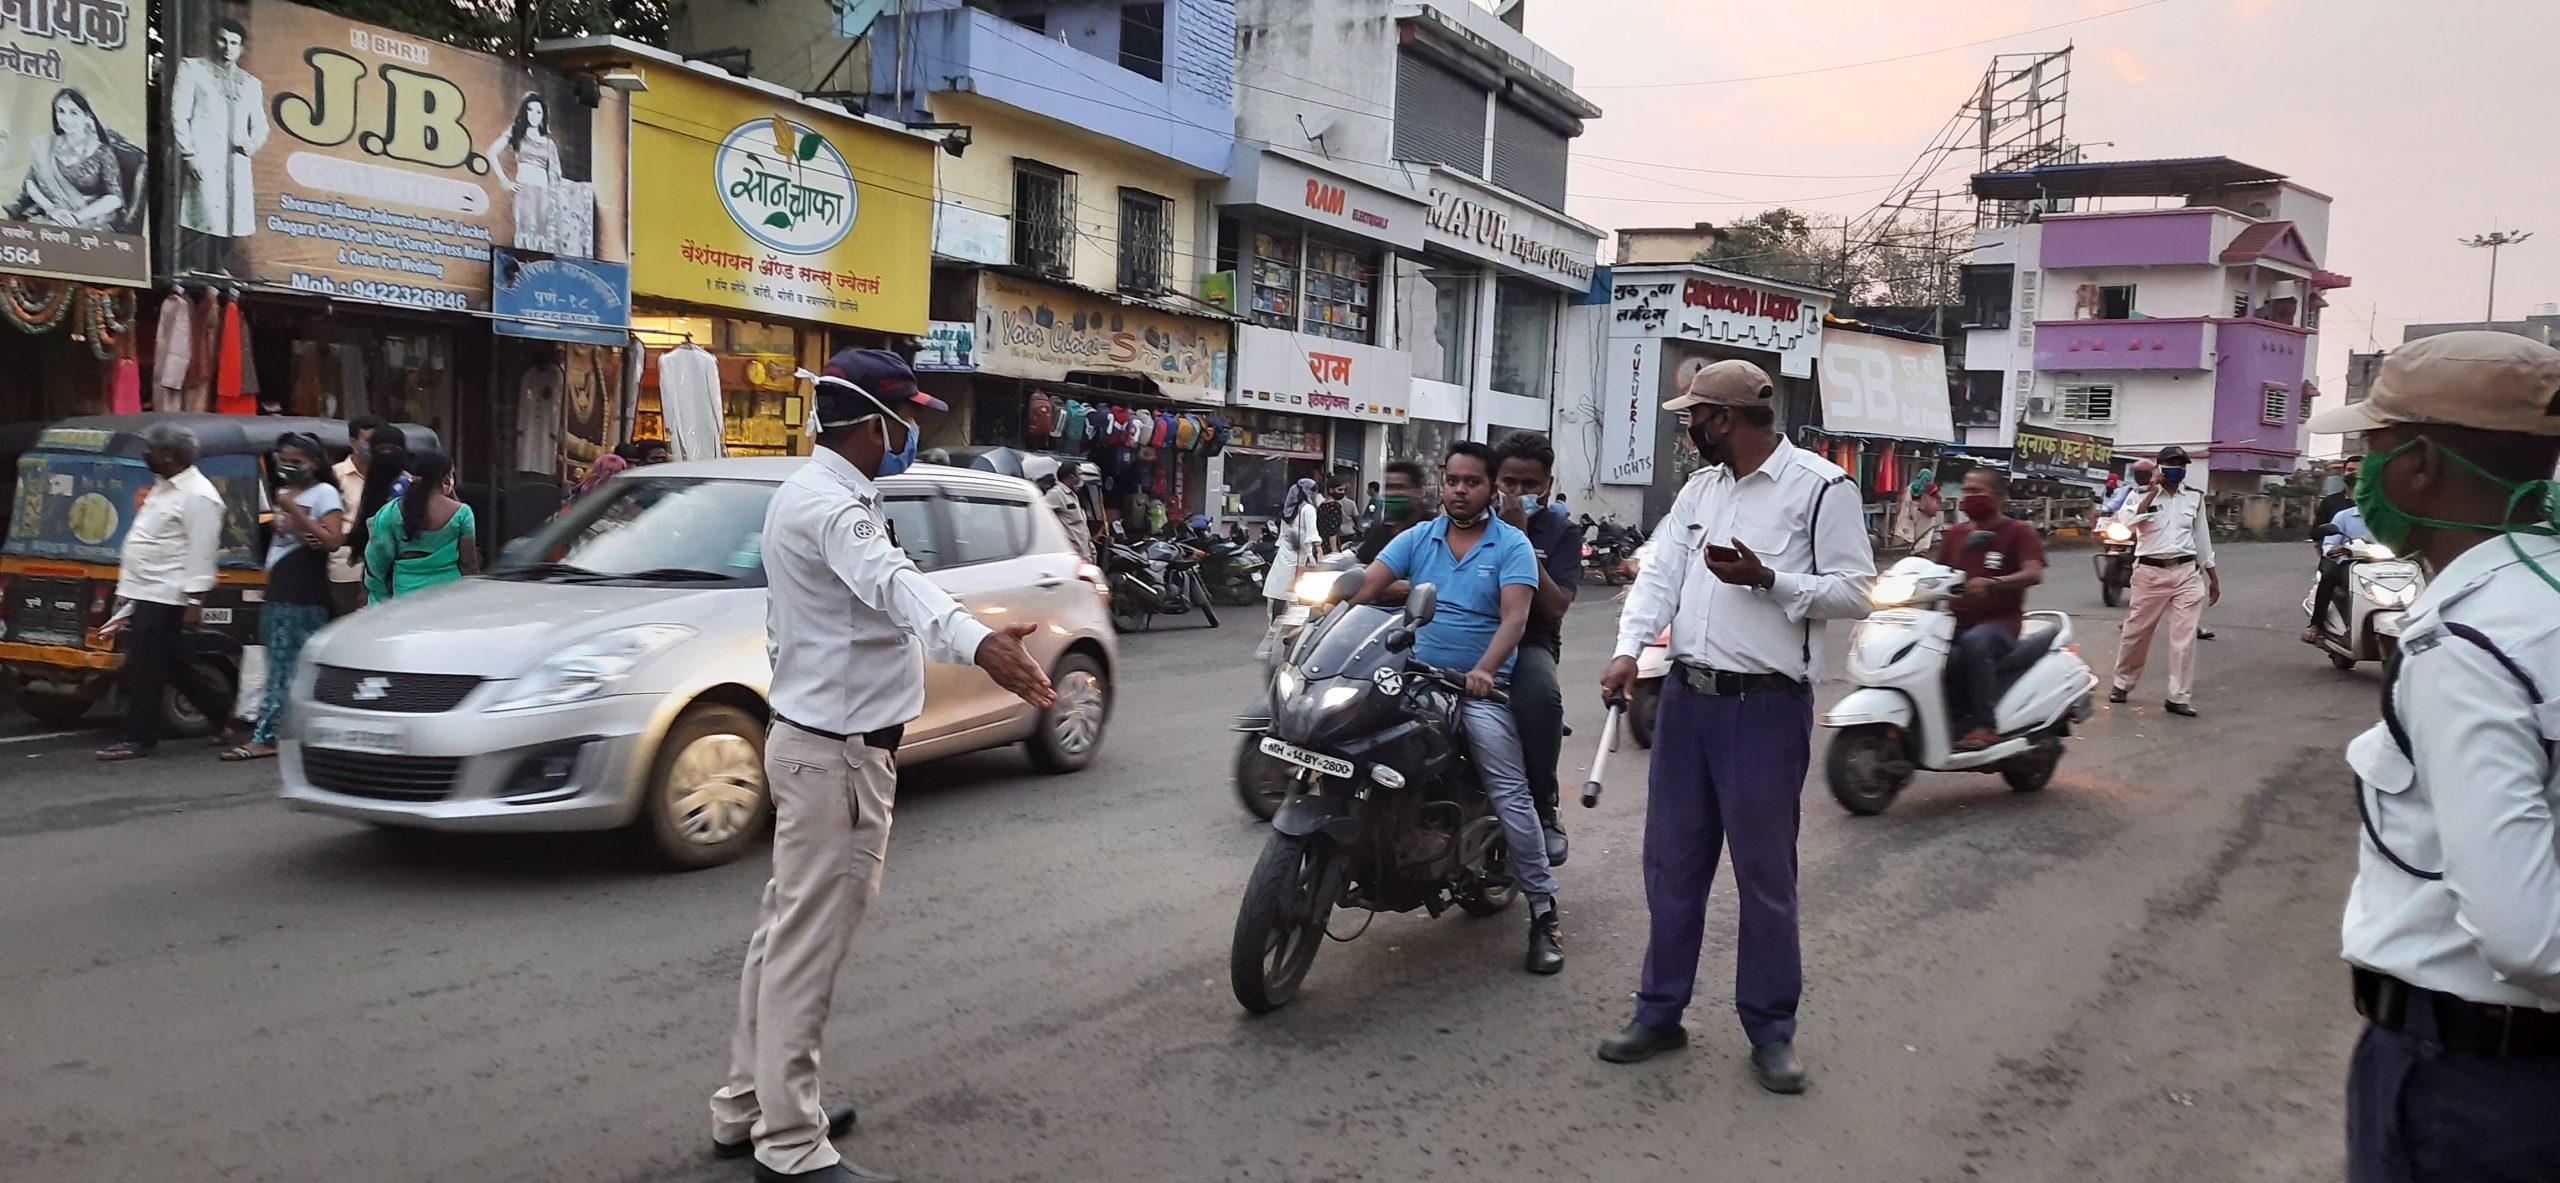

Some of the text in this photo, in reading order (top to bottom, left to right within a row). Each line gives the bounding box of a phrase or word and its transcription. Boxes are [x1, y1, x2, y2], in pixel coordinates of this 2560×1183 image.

[272, 47, 489, 176] J.B.
[1305, 179, 1346, 216] RAM
[267, 214, 316, 237] Ghagara
[1426, 188, 1509, 250] MAYUR
[1511, 233, 1550, 265] Lights
[338, 247, 444, 280] & Order For Wedding
[352, 279, 467, 309] 9422326846
[1308, 351, 1352, 386] राम
[1613, 456, 1652, 480] LIGHTS
